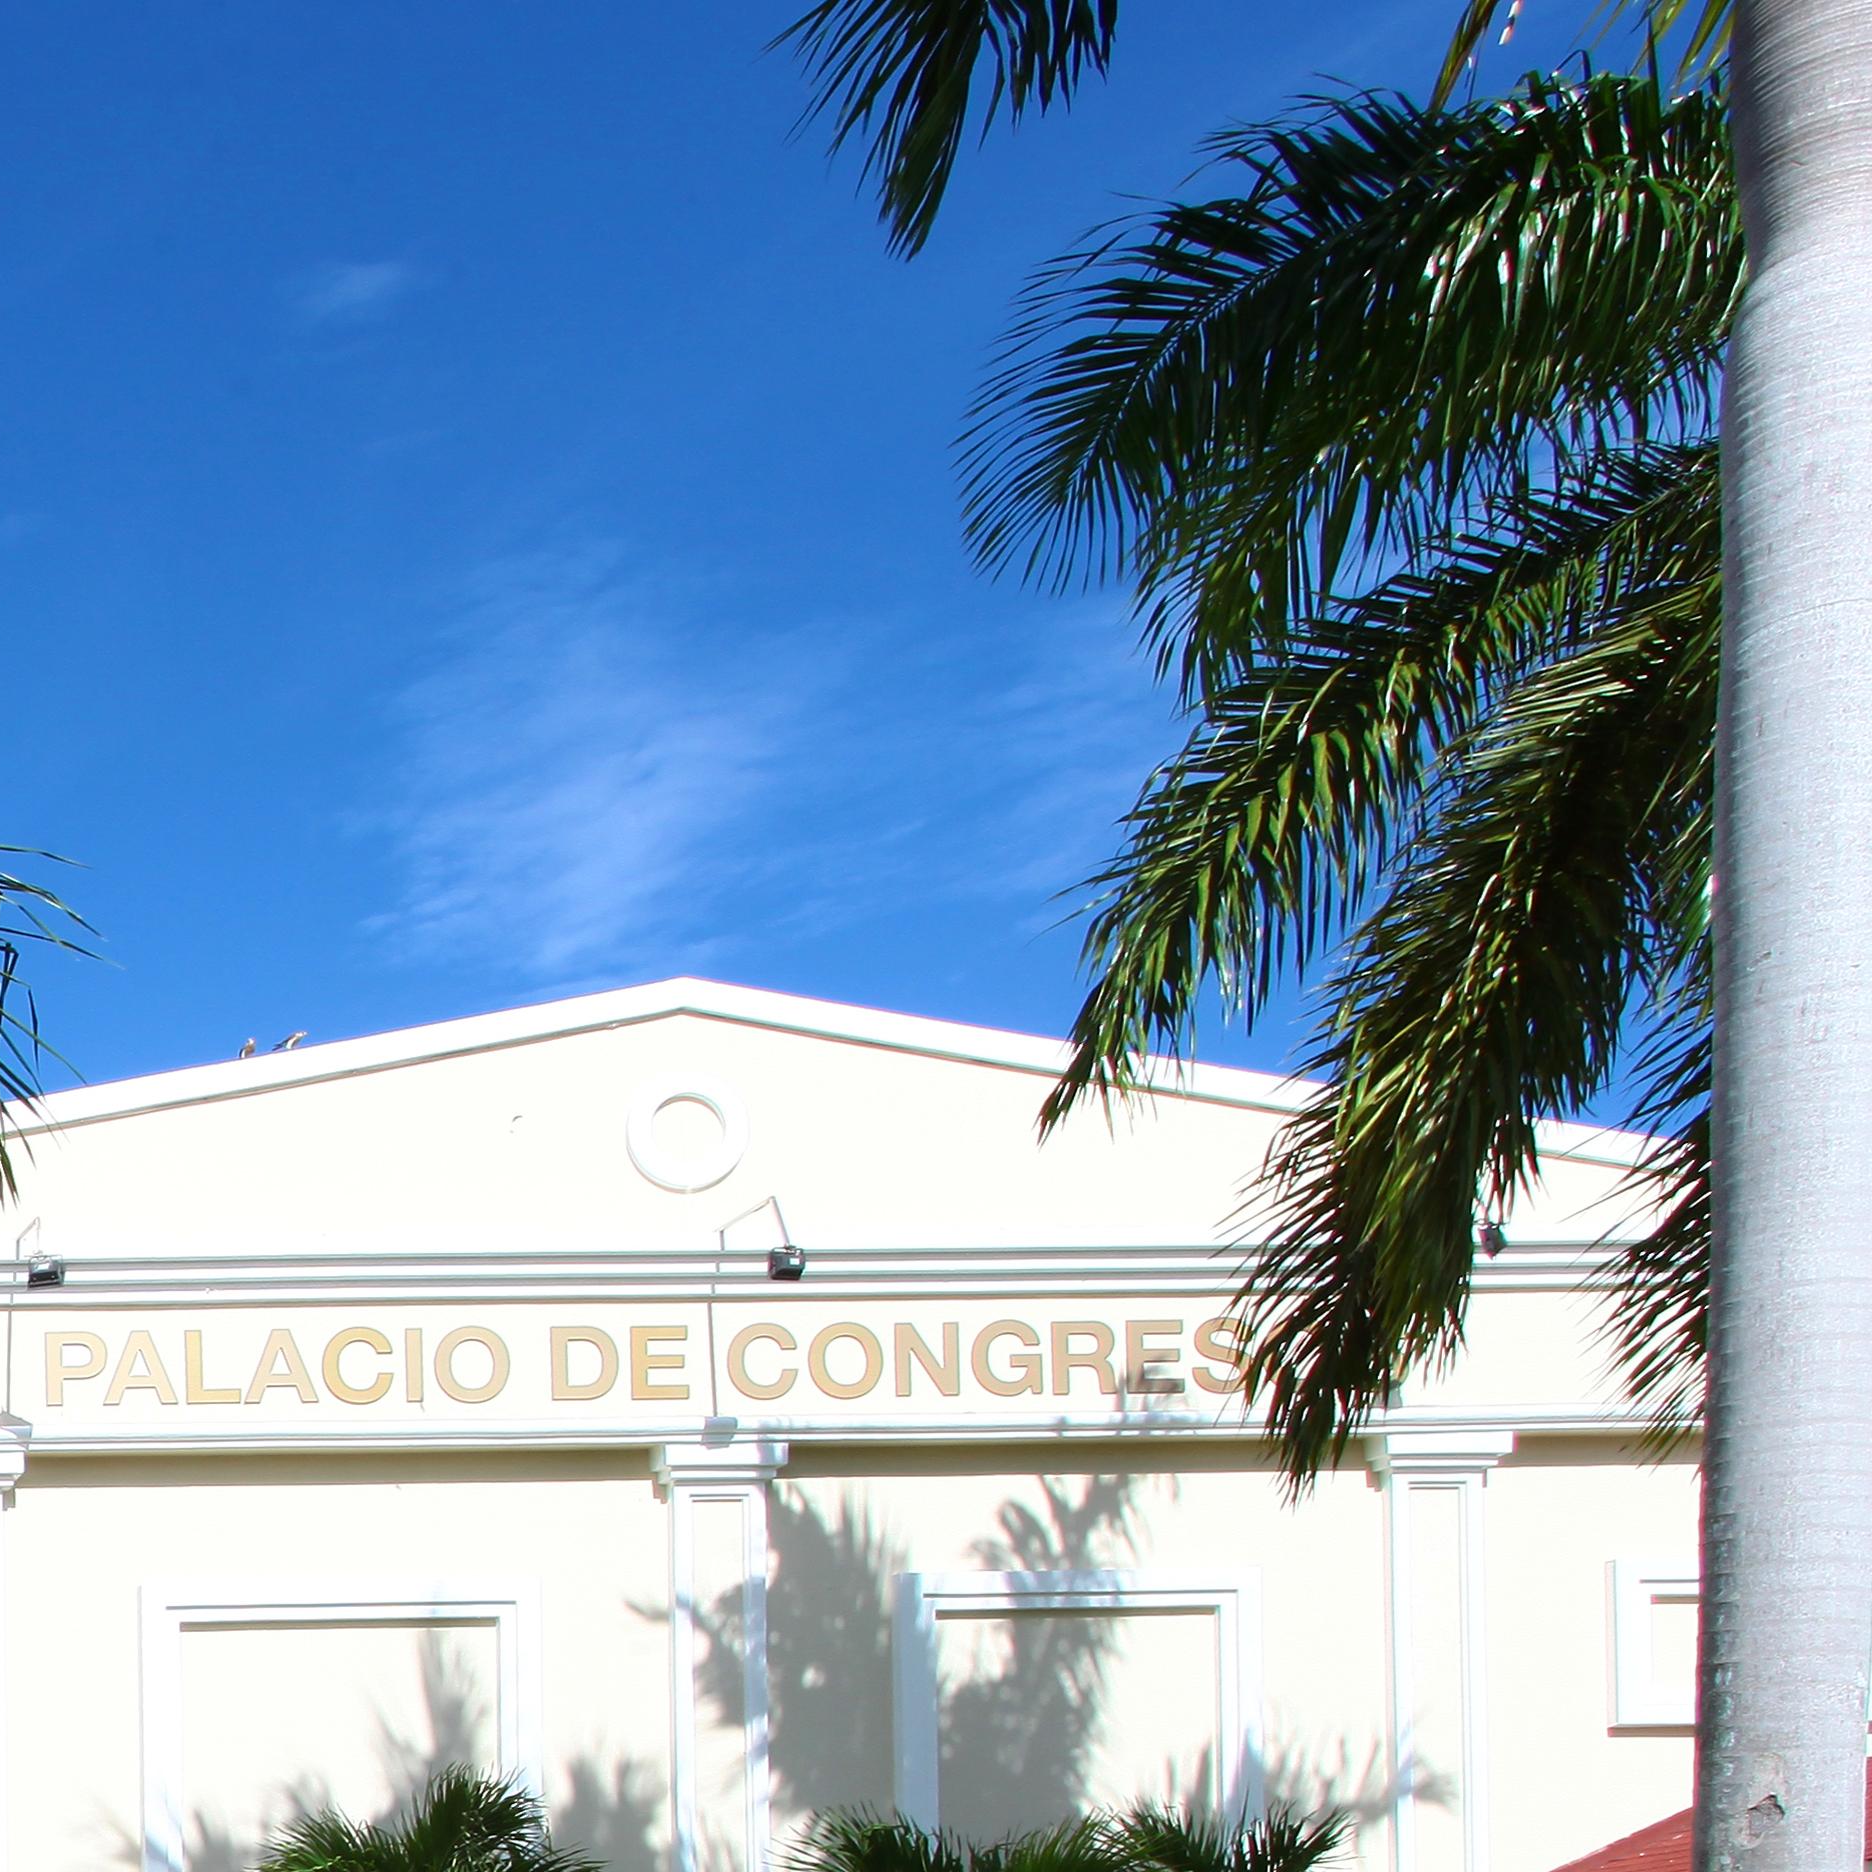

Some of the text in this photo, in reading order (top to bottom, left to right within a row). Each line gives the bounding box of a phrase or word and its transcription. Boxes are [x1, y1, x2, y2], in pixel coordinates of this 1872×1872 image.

[44, 1317, 1409, 1407] PALACIO DE CONGRES
